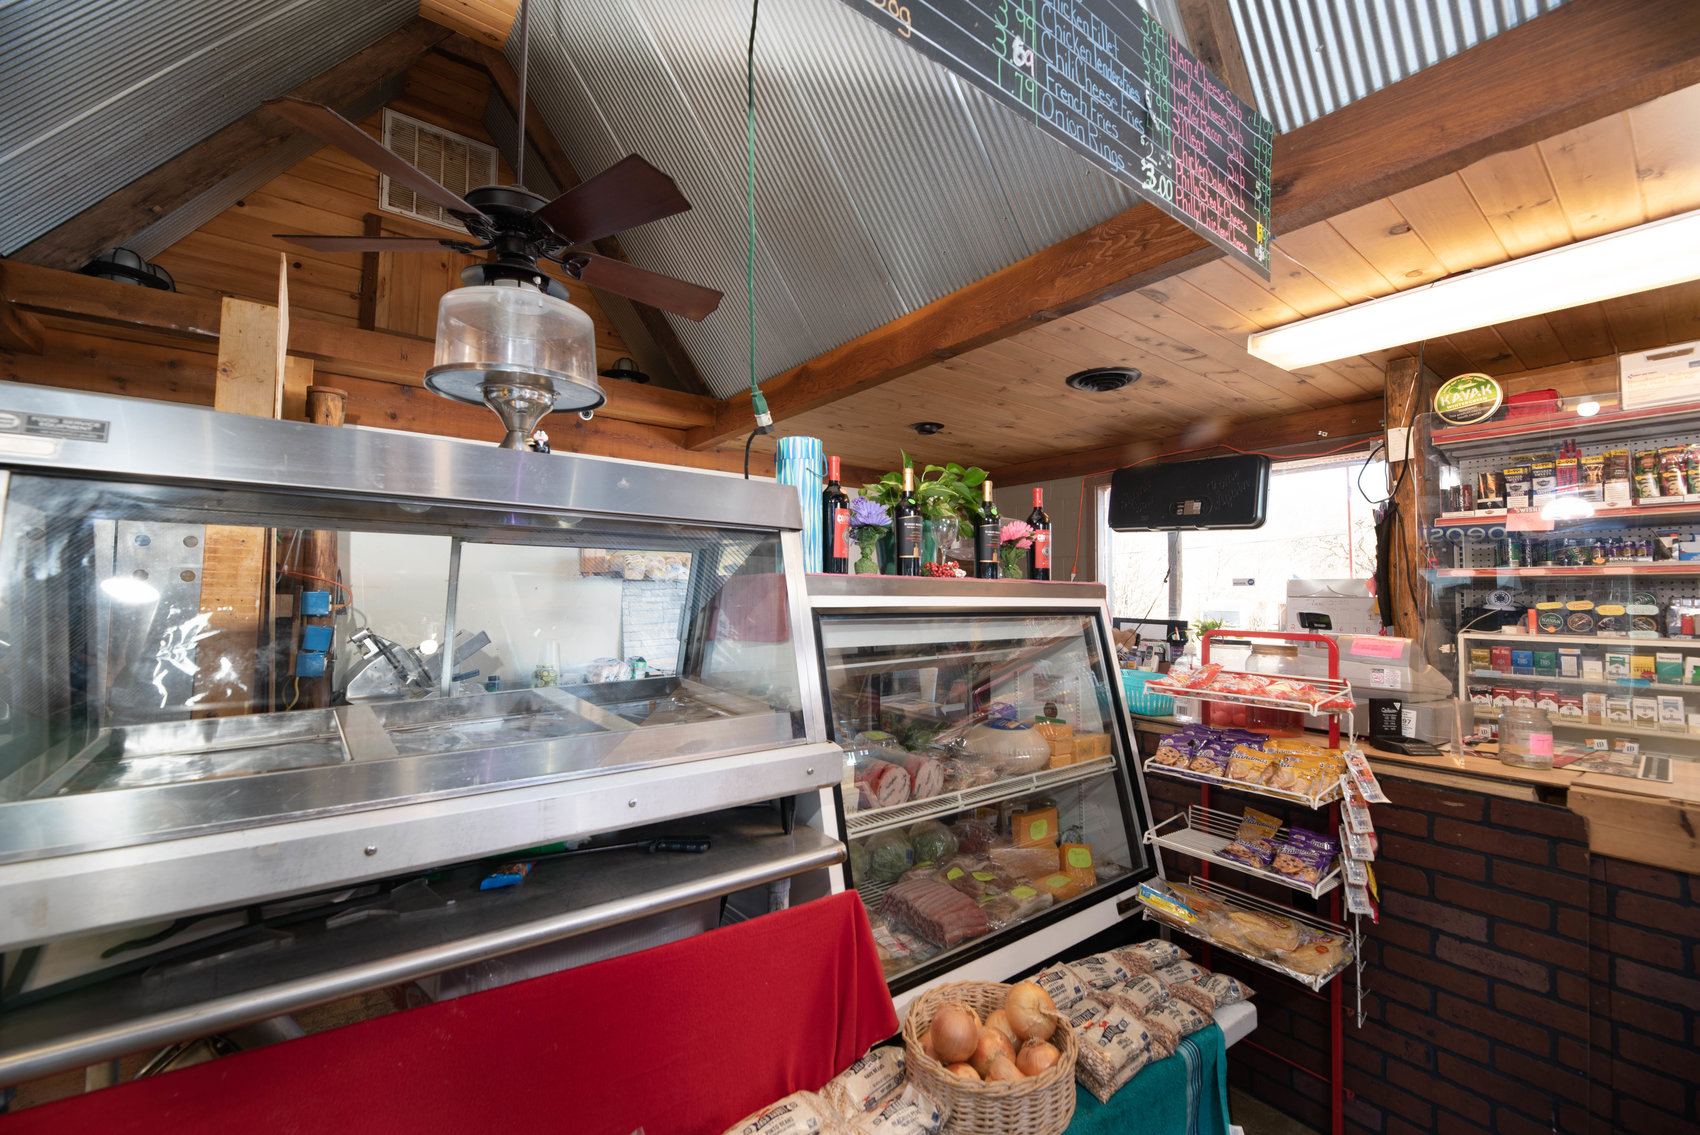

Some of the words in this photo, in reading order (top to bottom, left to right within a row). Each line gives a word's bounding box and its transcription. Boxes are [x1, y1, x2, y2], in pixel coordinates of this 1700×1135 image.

[1042, 92, 1085, 145] Onion
[1088, 120, 1124, 173] Rings
[1046, 63, 1088, 119] French
[1091, 97, 1119, 139] Fries
[1441, 384, 1493, 407] KAYAK
